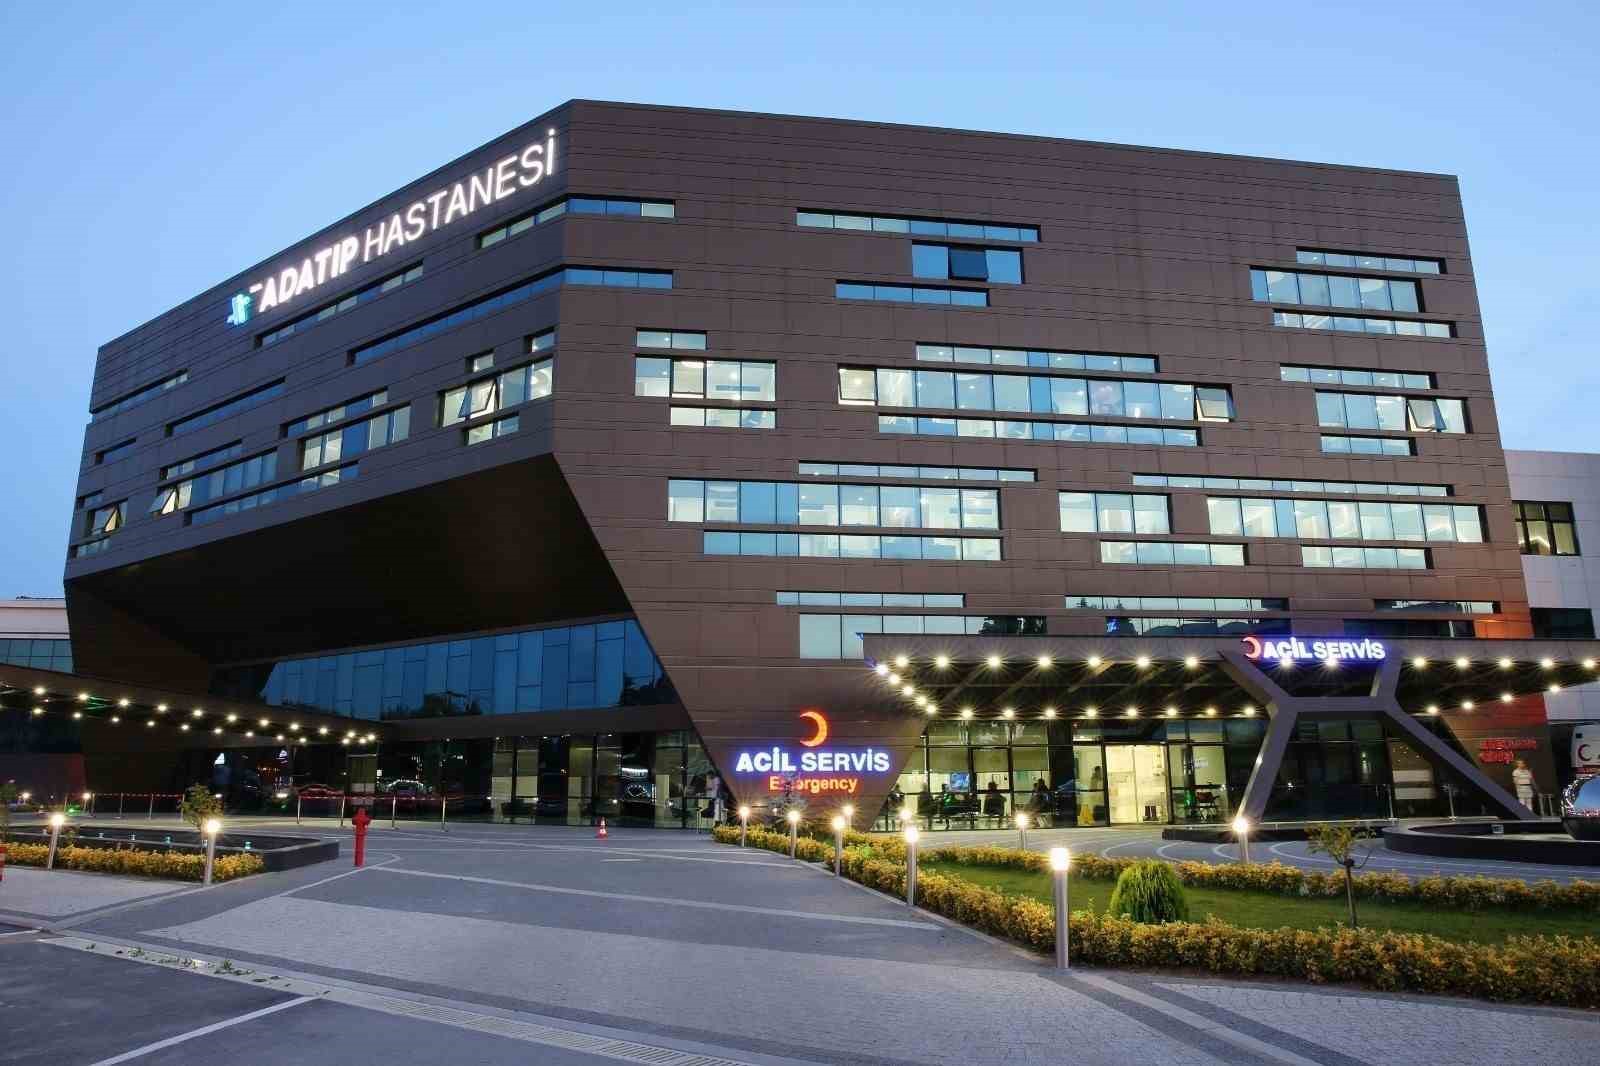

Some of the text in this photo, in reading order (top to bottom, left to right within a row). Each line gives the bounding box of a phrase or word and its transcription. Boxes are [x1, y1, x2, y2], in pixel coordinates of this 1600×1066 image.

[258, 128, 556, 313] ADATIP HASTANESİ
[1263, 636, 1386, 660] ACİL SERVİS
[736, 747, 890, 772] ACİL SERVİS
